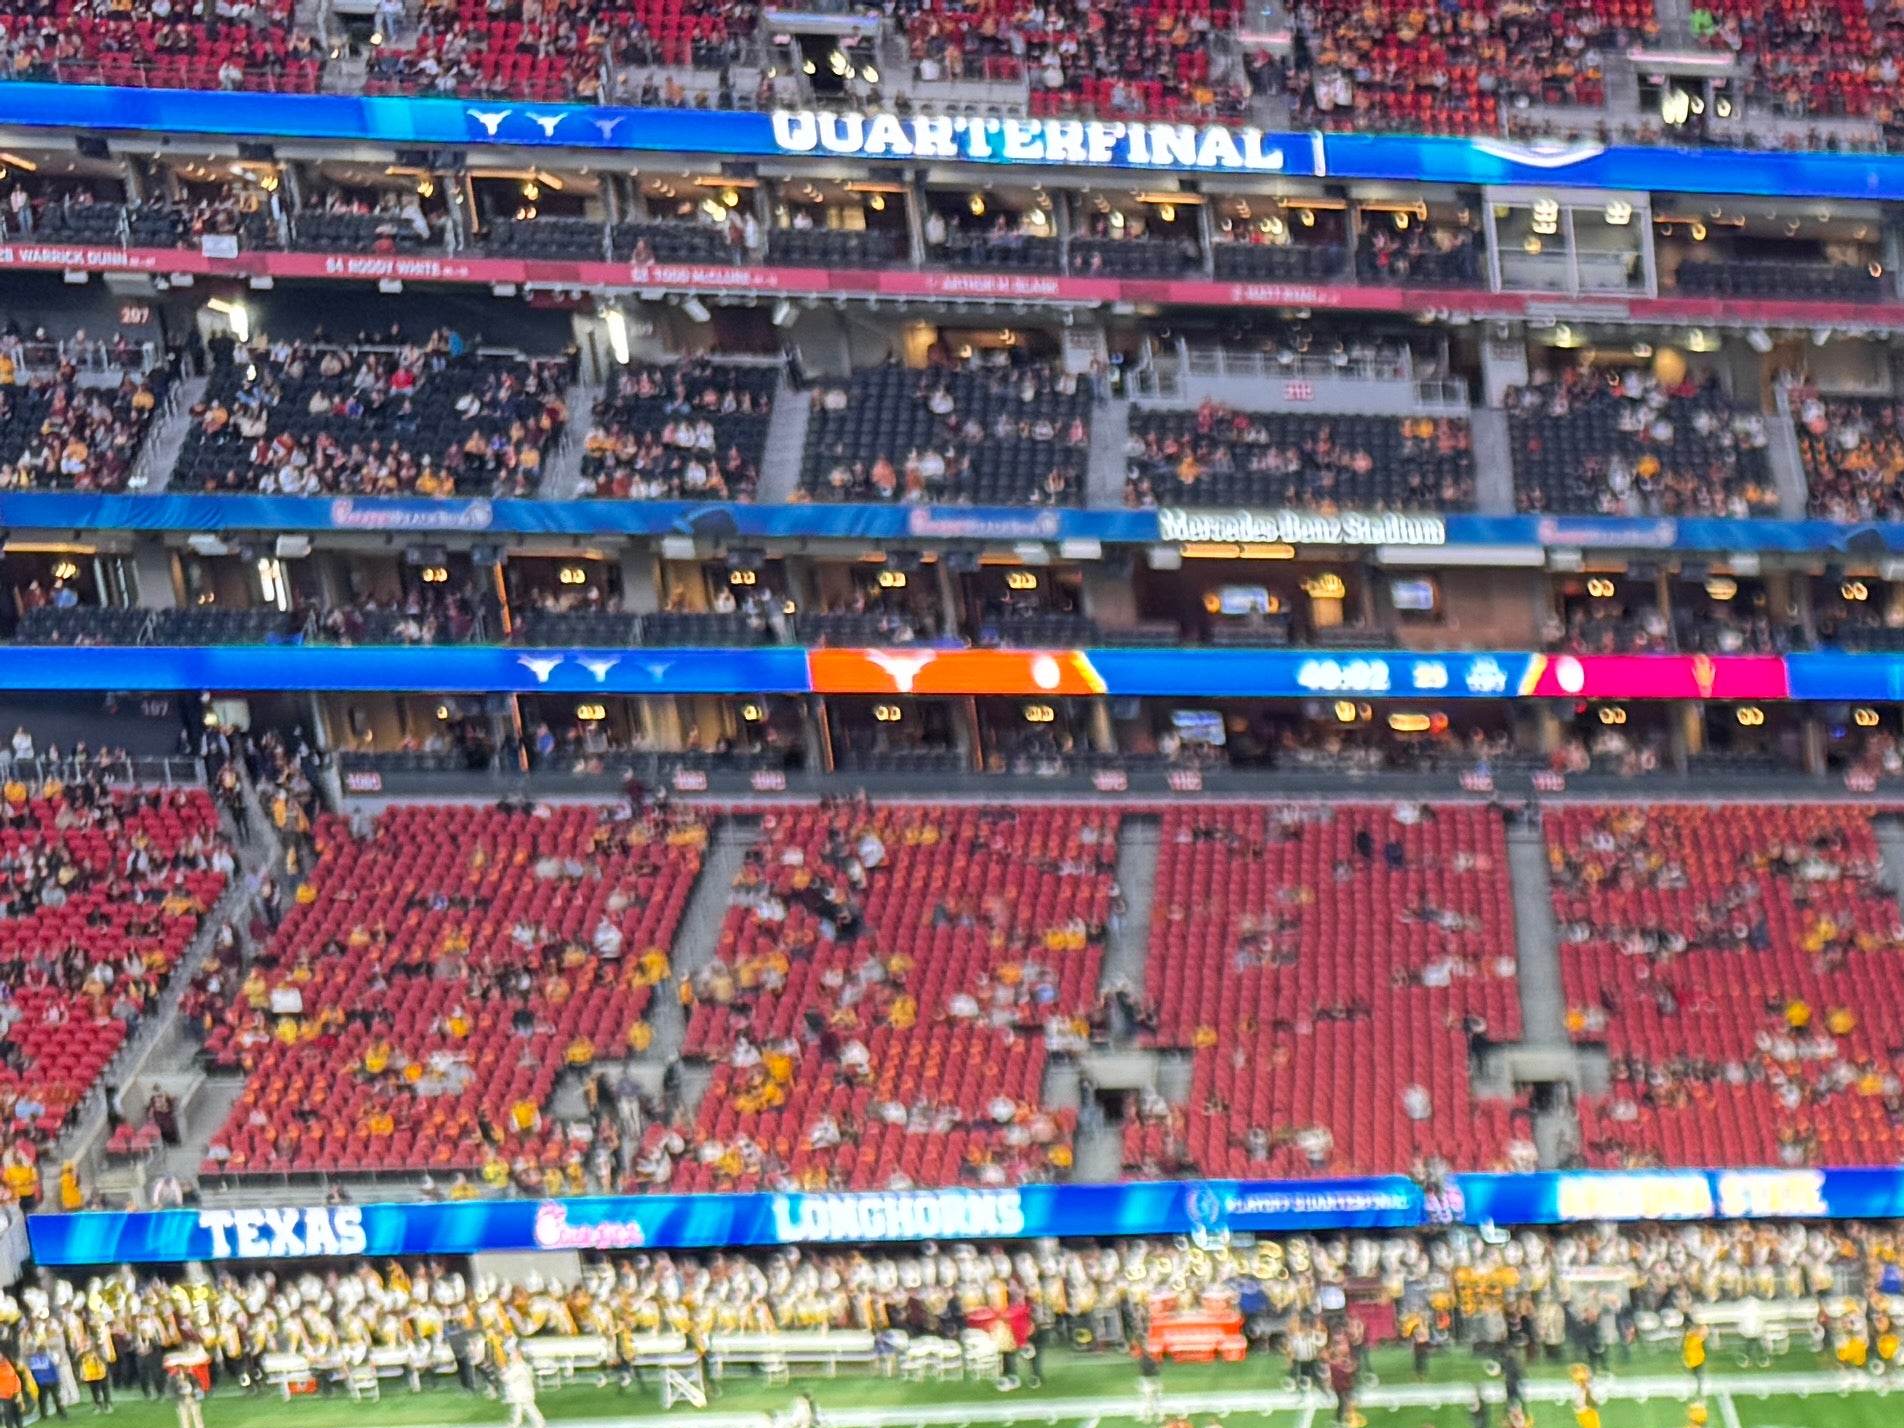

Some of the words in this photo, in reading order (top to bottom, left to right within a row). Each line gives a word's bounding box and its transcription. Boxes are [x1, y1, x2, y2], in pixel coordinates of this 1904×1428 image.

[770, 110, 1284, 170] QUARTERFINAL
[199, 1206, 366, 1257] TEXAS
[774, 1188, 1025, 1242] LONGHORNS
